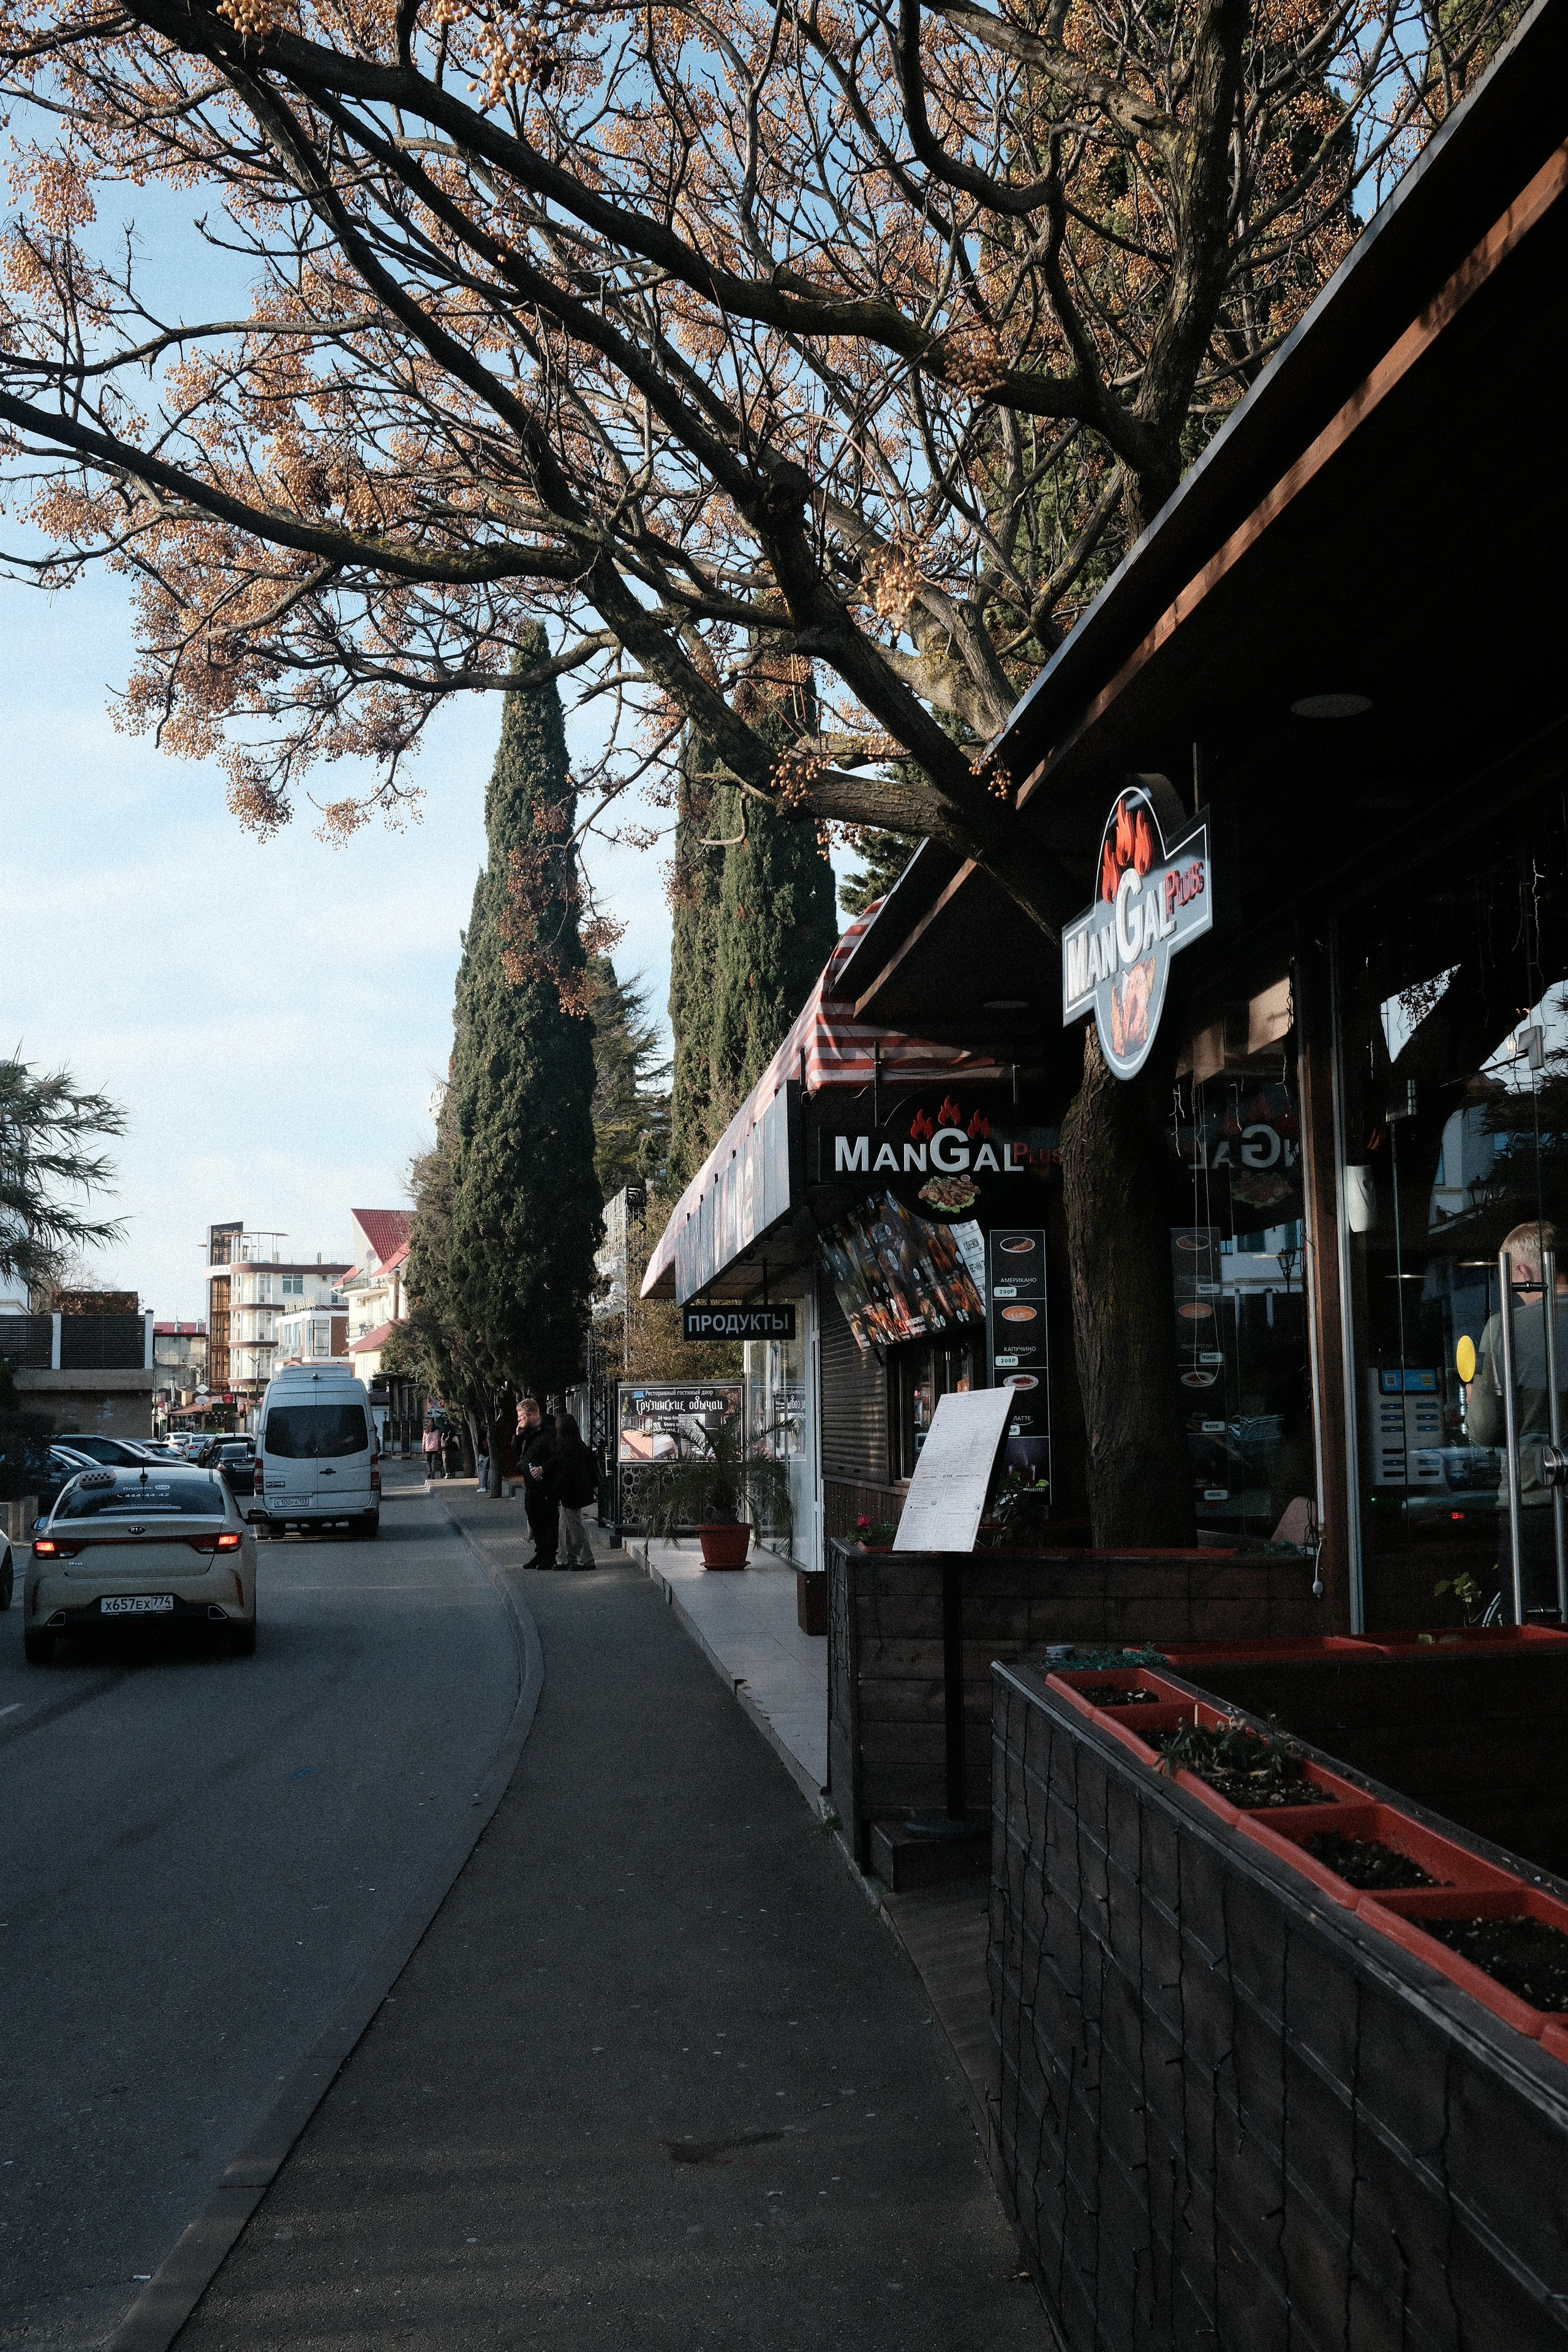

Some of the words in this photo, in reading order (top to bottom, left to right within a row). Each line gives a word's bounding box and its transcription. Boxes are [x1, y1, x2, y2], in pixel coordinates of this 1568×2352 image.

[688, 1313, 788, 1334] ПРОДУКТЫ
[689, 1396, 723, 1411] обычаи
[153, 1596, 171, 1606] 774
